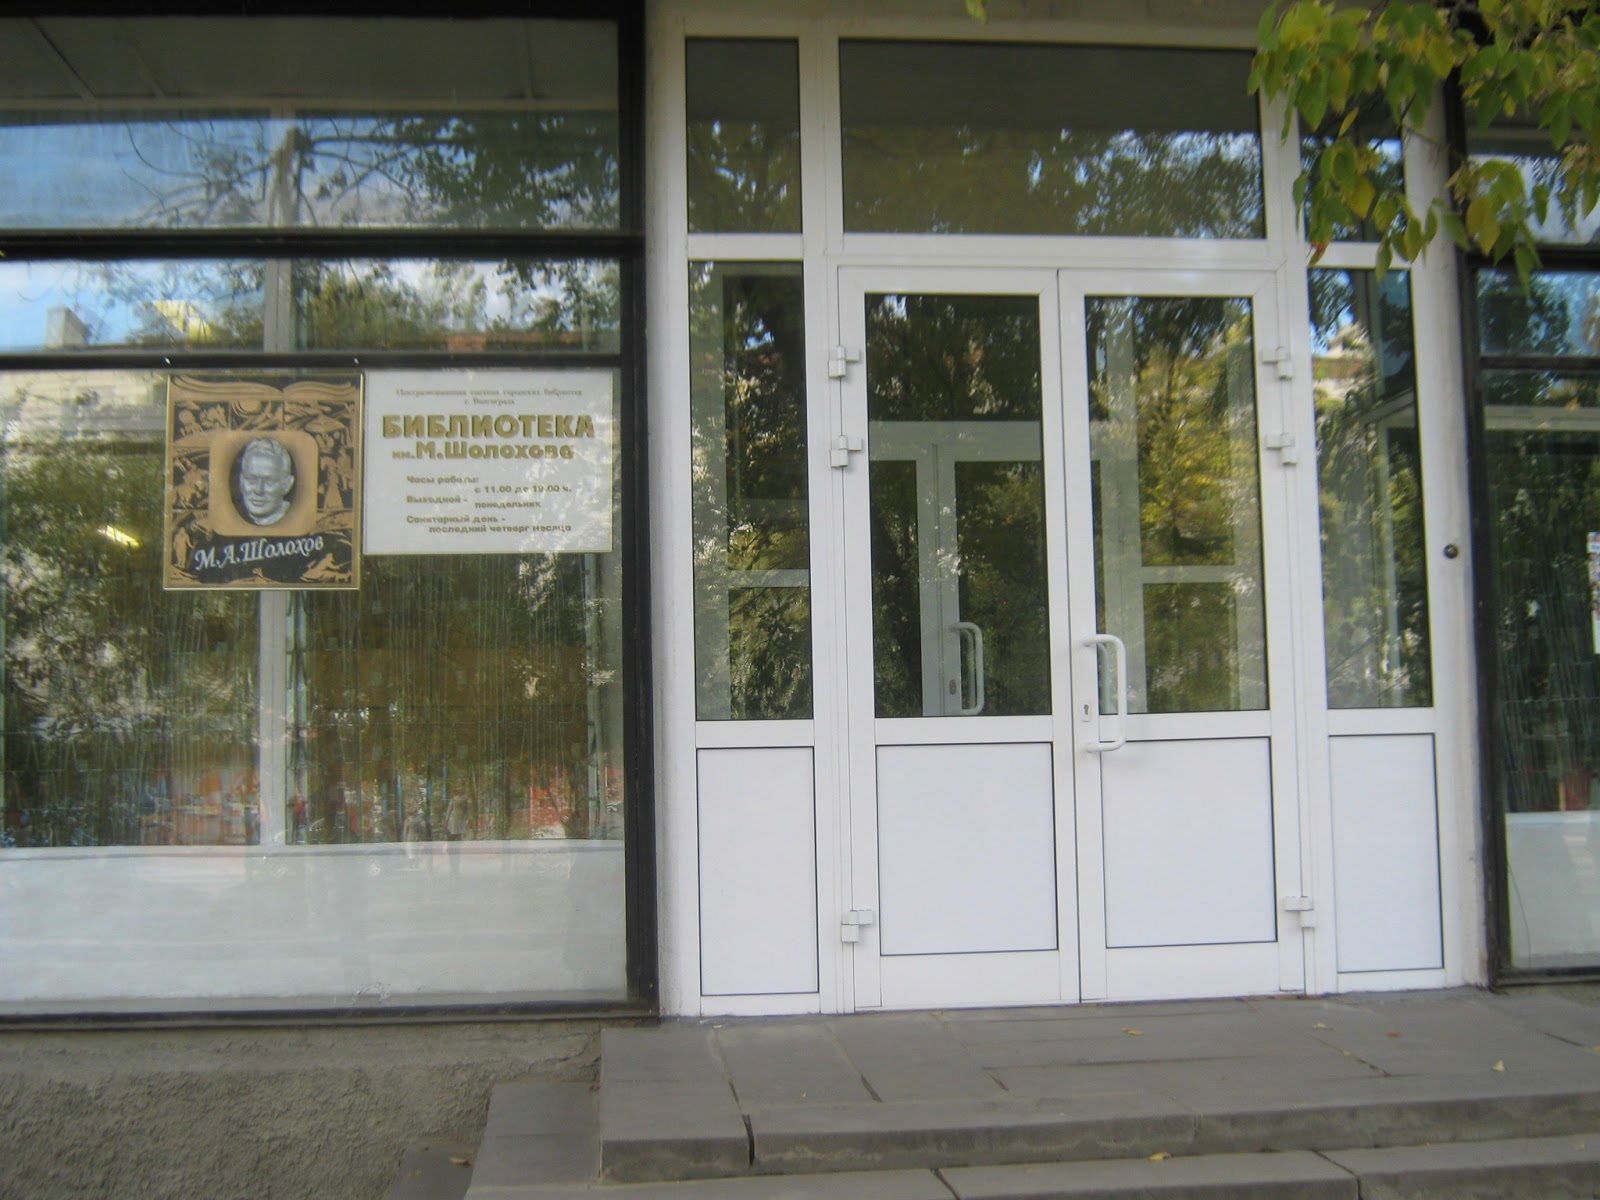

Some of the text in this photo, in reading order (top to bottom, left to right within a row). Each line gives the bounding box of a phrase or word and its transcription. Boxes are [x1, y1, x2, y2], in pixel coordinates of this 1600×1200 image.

[382, 414, 595, 438] БИБЛИОТЕКА
[407, 475, 434, 483] Часы
[485, 485, 512, 493] 11.00
[533, 485, 560, 493] 19.00
[407, 495, 461, 504] Выходной
[475, 501, 541, 510] понедельник
[406, 514, 470, 524] Санитарный
[473, 516, 498, 524] день
[429, 525, 486, 534] последний
[489, 525, 529, 534] четверг
[194, 535, 324, 571] М.А.Шолохов
